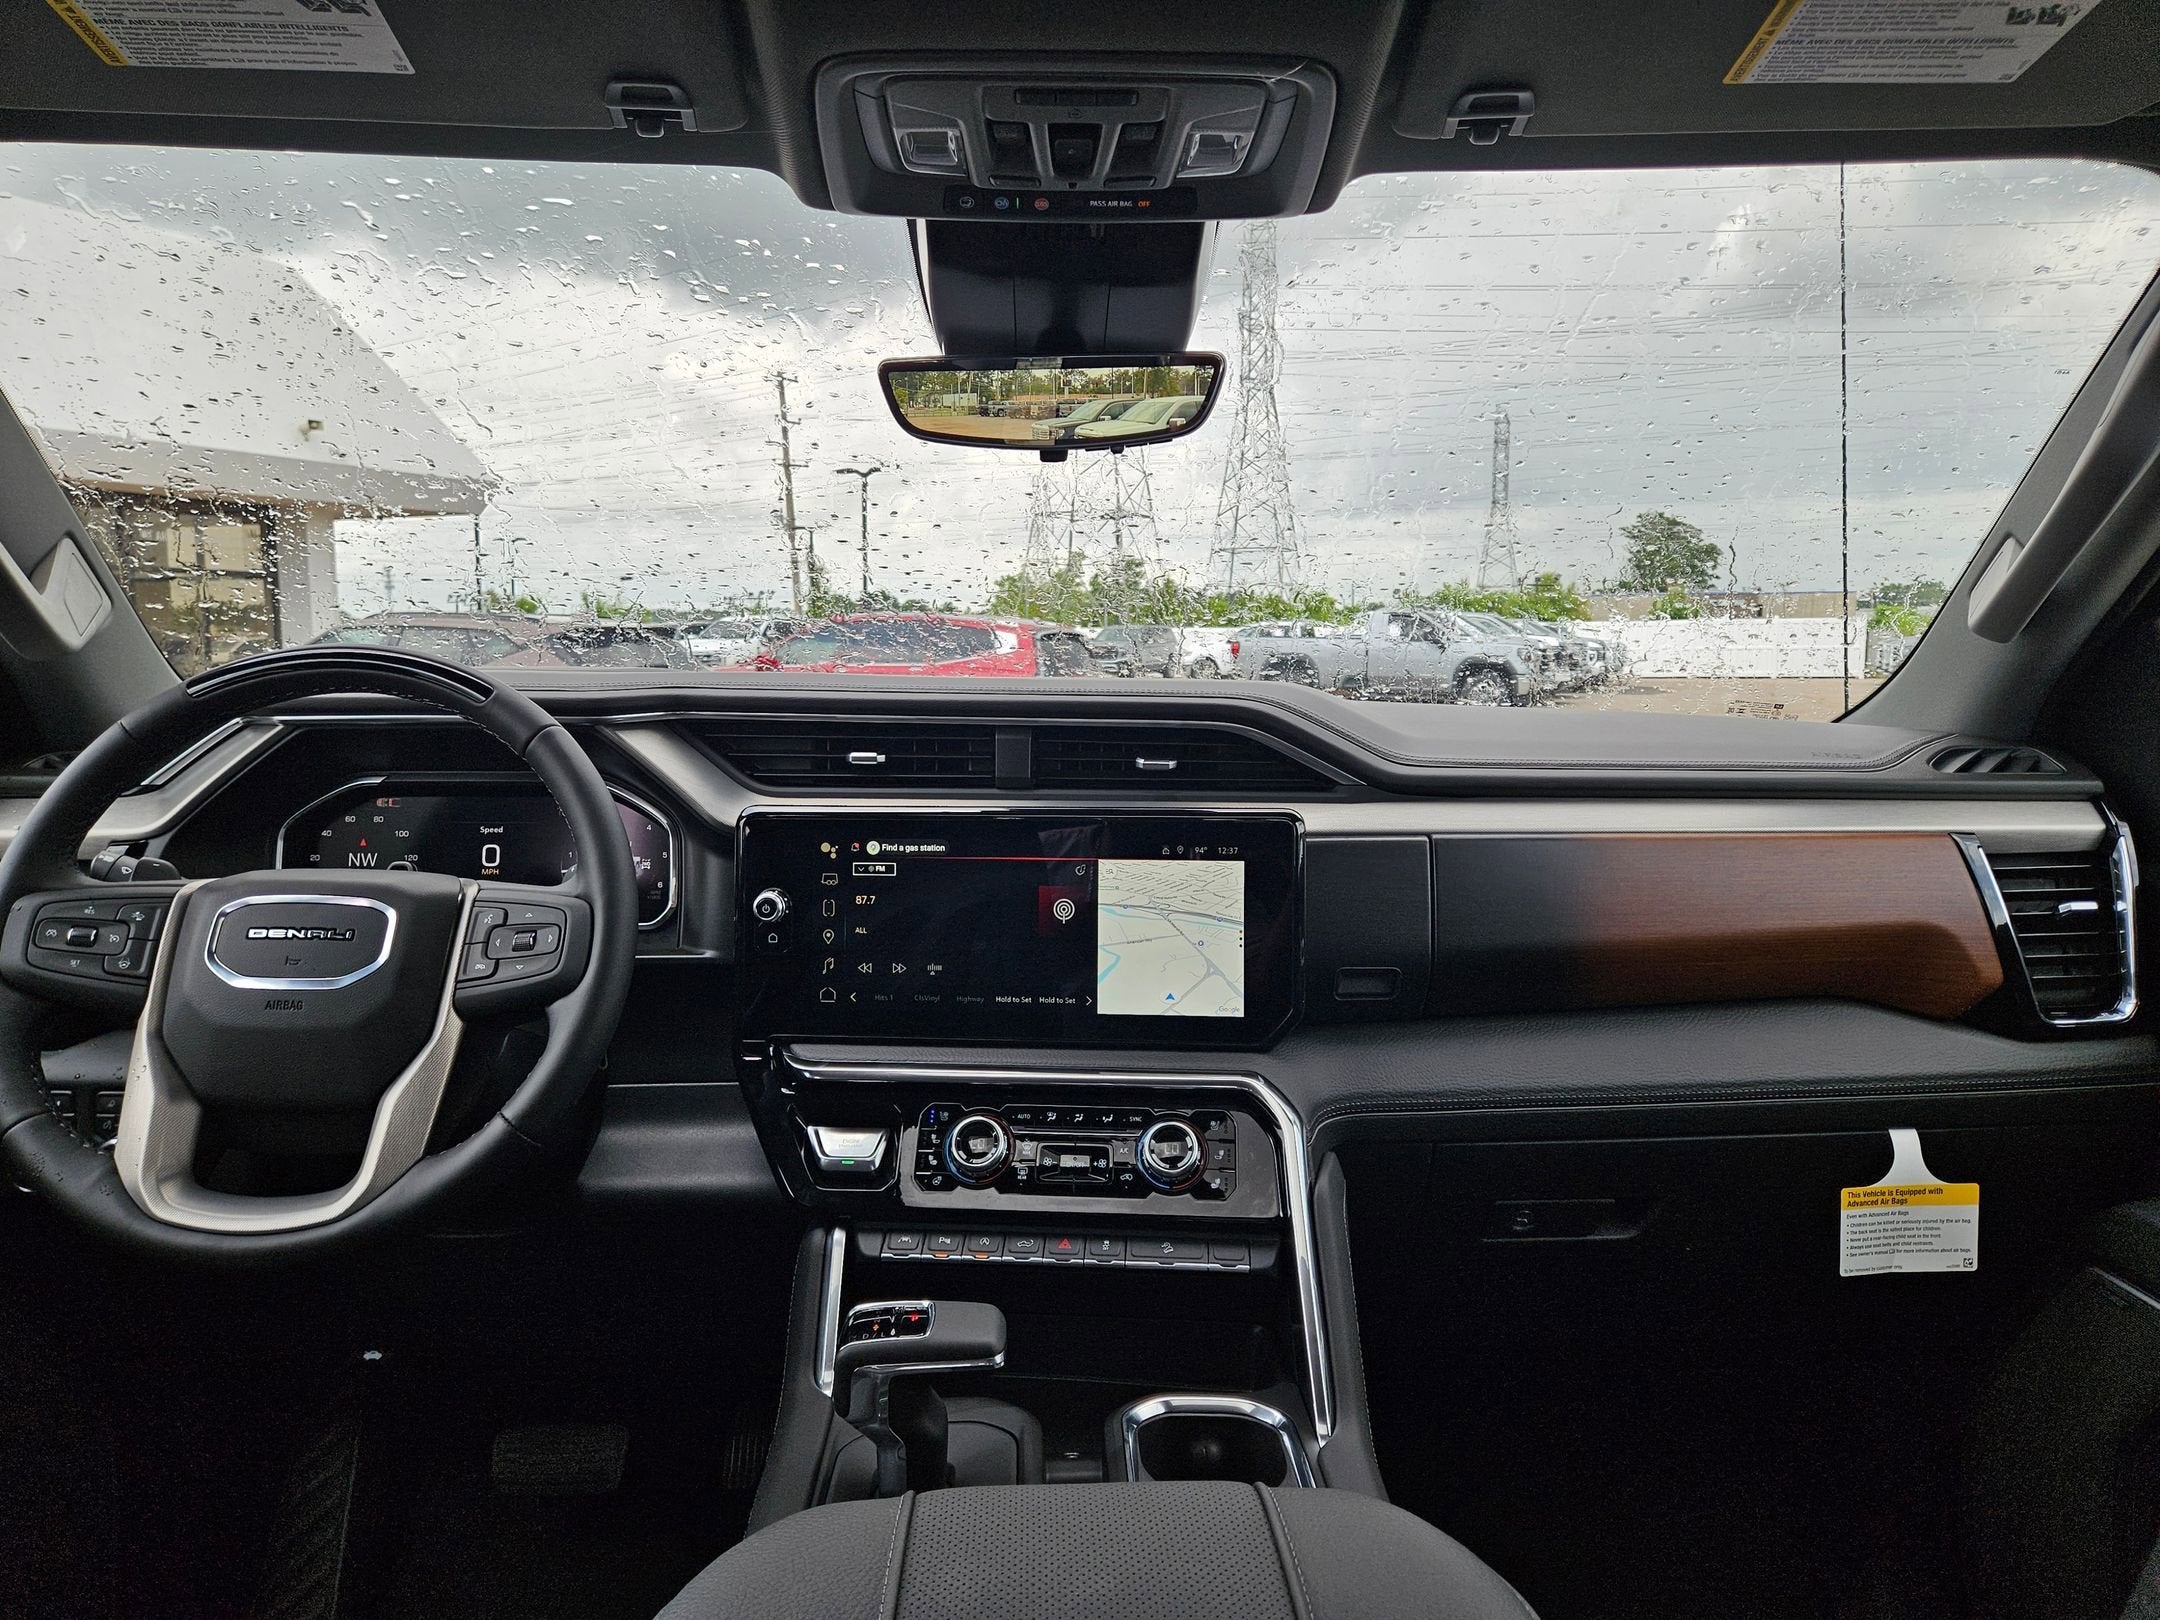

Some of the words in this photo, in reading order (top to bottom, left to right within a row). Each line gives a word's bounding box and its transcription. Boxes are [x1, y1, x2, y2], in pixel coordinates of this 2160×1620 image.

[480, 825, 504, 835] Speed
[881, 843, 898, 852] Find
[905, 845, 919, 853] gas
[920, 843, 946, 852] station
[1218, 846, 1239, 854] 12:37
[310, 854, 320, 862] 20
[348, 852, 378, 867] NW
[405, 854, 418, 862] 120
[482, 844, 501, 867] 0
[855, 895, 876, 905] 87.7
[247, 928, 355, 940] DENALI
[956, 995, 985, 1004] Highway
[1039, 996, 1055, 1004] Hold
[265, 1000, 303, 1011] AIRBAG
[1895, 1188, 1926, 1196] Equipped
[1847, 1199, 1878, 1207] Advanced
